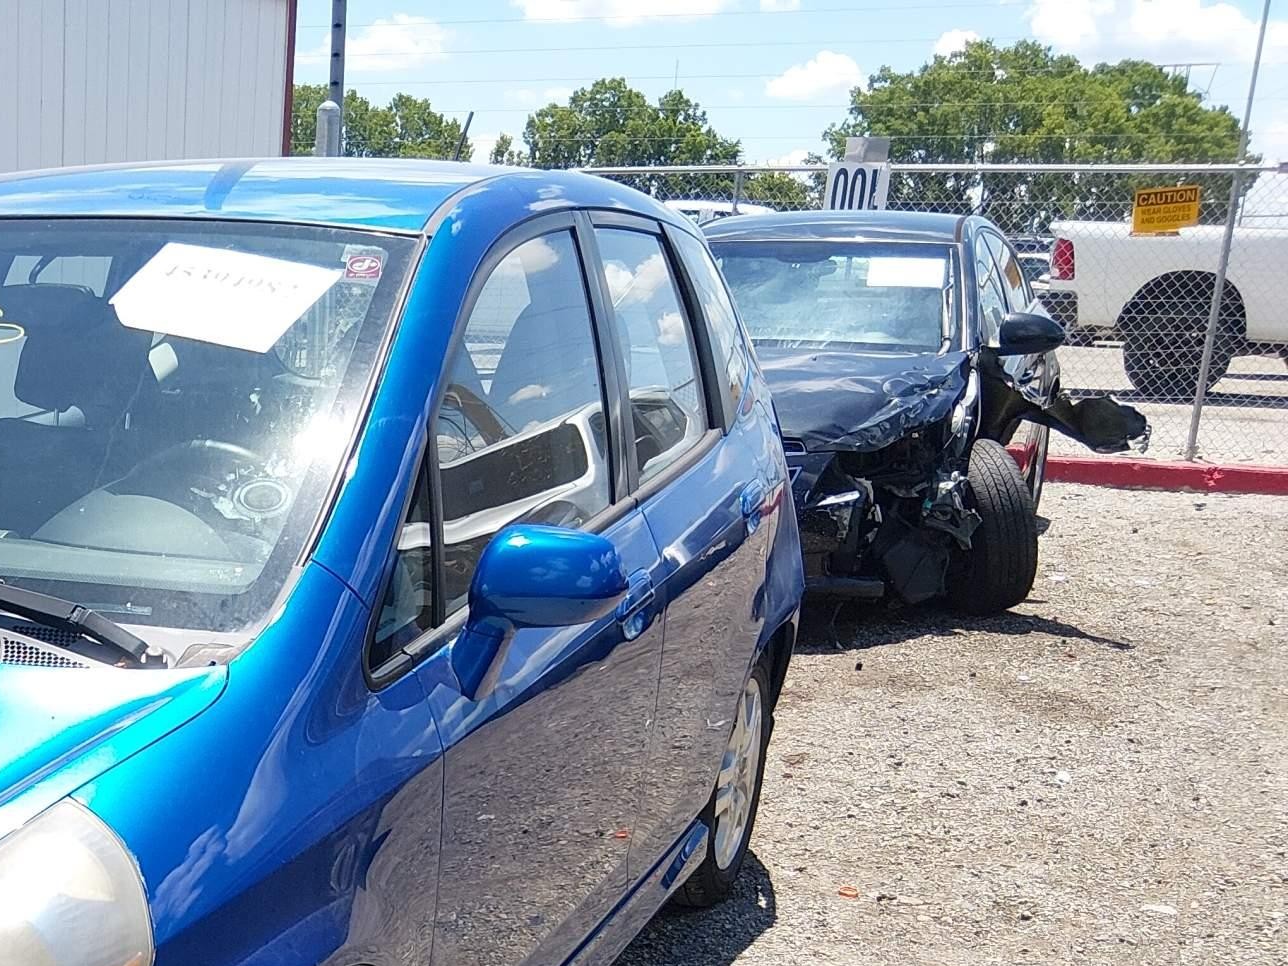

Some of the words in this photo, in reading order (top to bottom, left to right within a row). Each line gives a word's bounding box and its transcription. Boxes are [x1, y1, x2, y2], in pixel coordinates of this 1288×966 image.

[1138, 189, 1196, 206] CAUTION
[1140, 208, 1162, 216] WEAR
[1163, 203, 1192, 214] GLOVES
[1140, 217, 1155, 225] AND
[1156, 213, 1191, 224] GOGGLES
